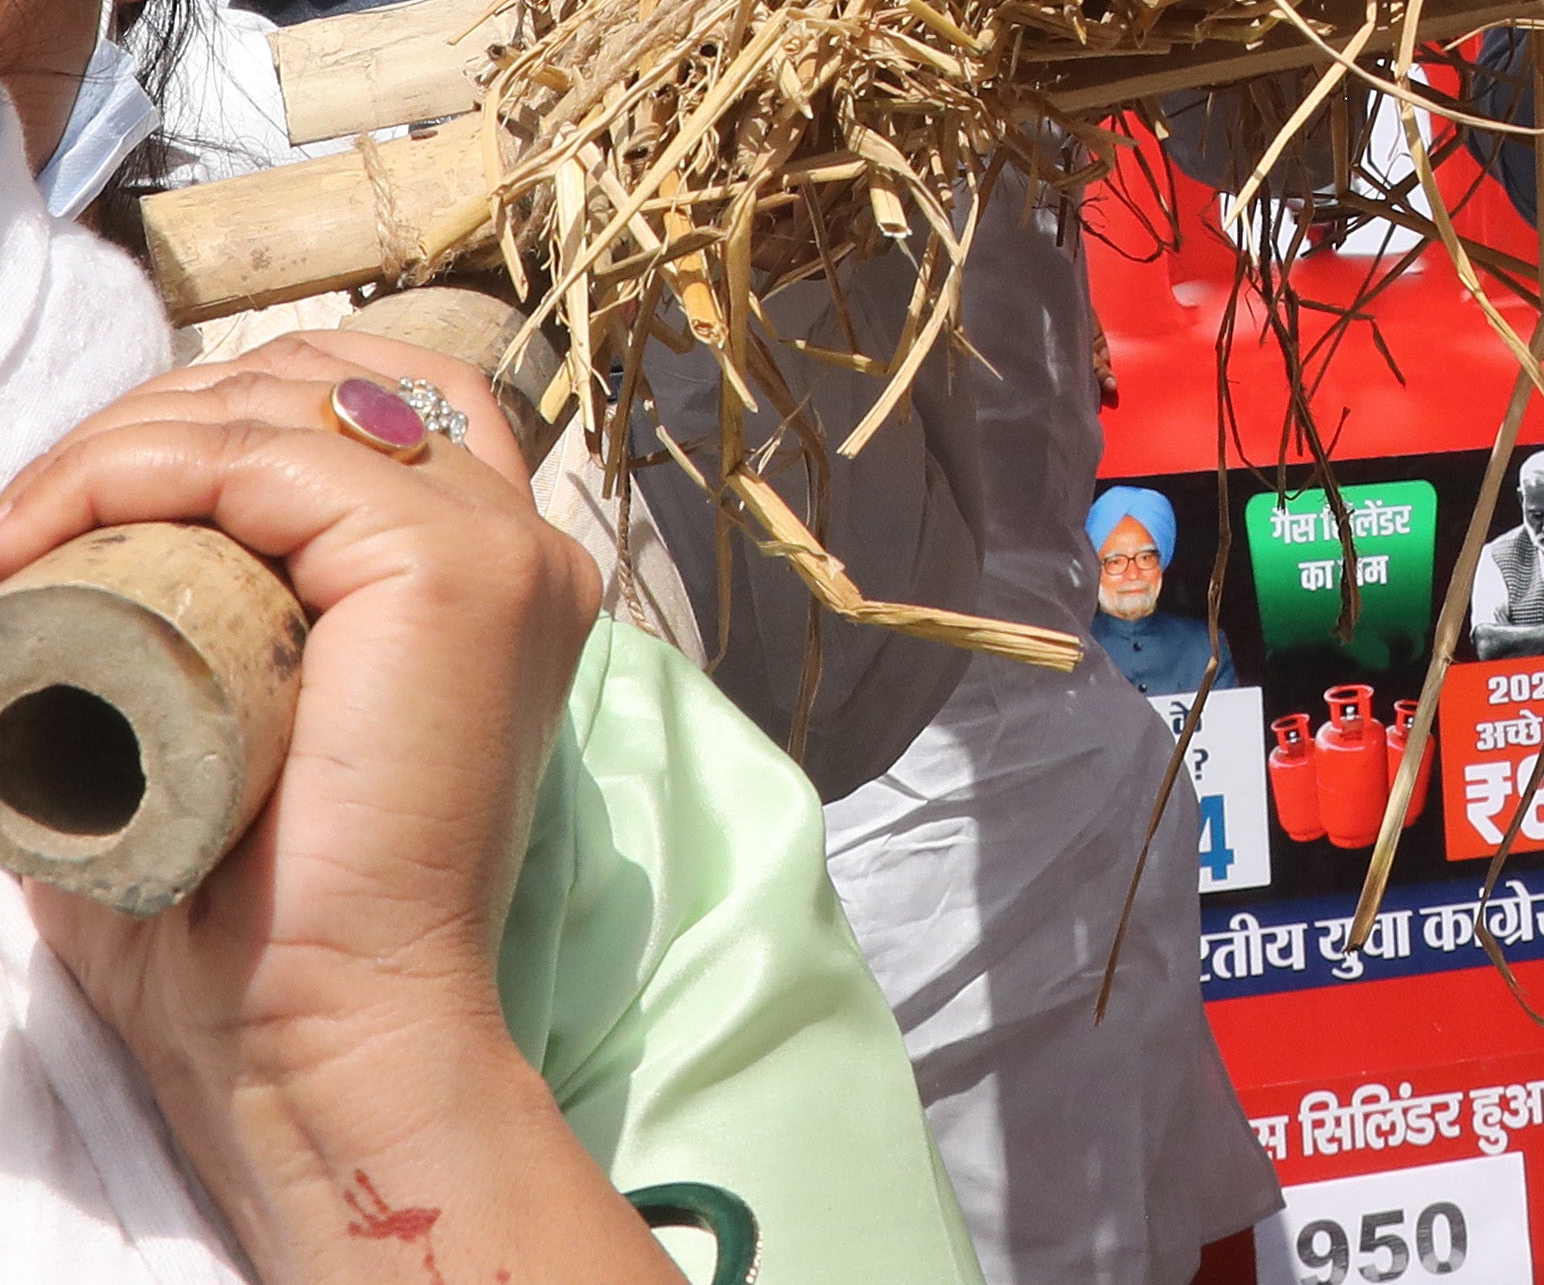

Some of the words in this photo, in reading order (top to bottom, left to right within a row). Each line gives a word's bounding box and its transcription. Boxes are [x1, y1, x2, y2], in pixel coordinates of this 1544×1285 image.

[1298, 560, 1335, 591] का
[1476, 709, 1542, 751] अच्छे
[1314, 910, 1413, 980] युवा
[1297, 1081, 1464, 1157] सिलिंडर
[1295, 1201, 1468, 1285] 950
